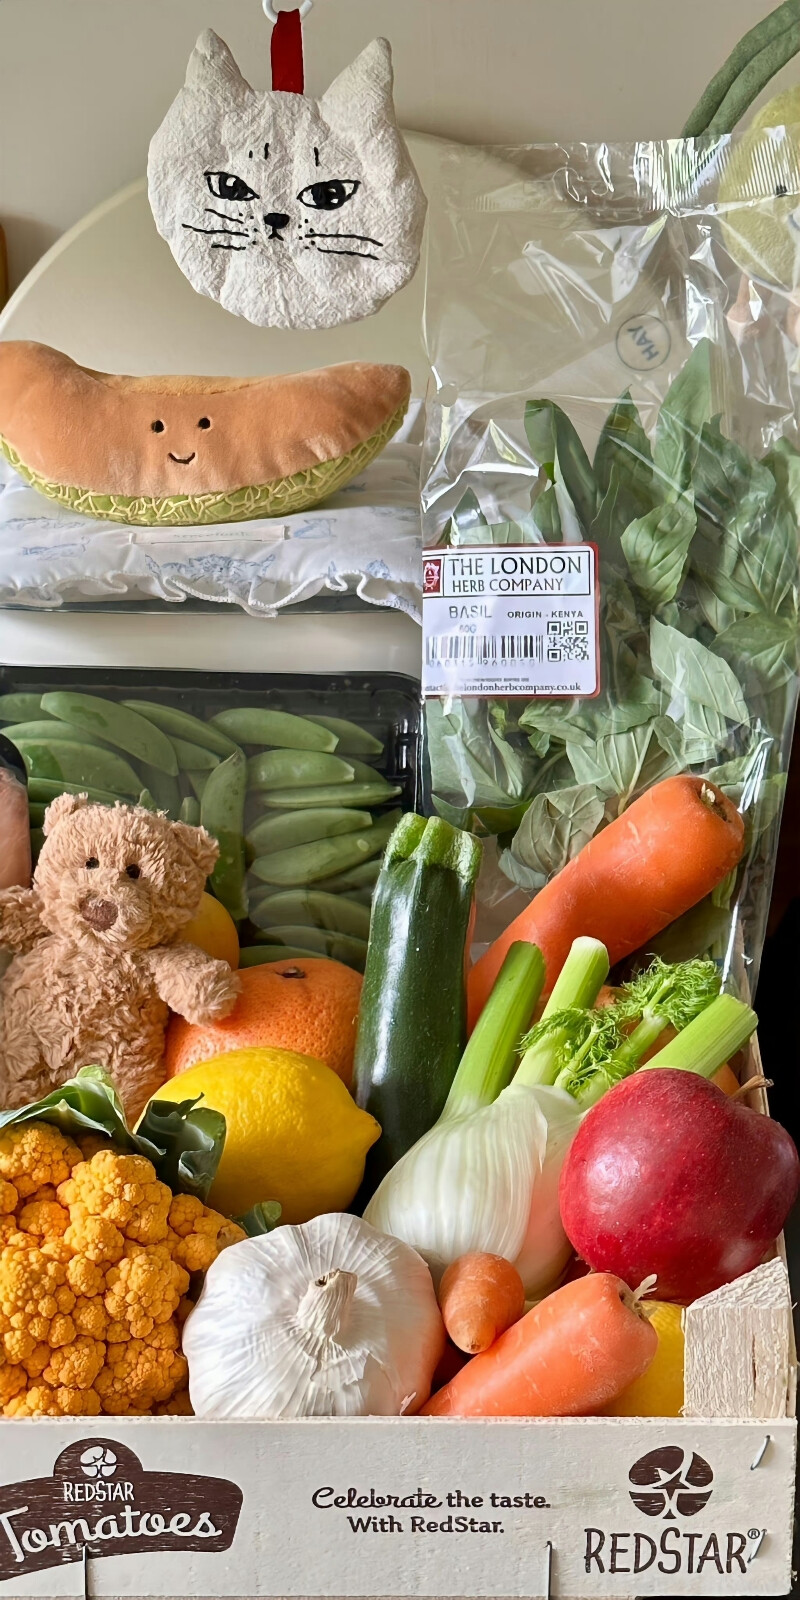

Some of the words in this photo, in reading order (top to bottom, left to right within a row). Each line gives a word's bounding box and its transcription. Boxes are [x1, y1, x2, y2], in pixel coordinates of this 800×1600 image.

[627, 325, 660, 361] HAY
[449, 557, 484, 576] THE
[491, 556, 581, 575] LONDON
[452, 579, 485, 593] HERB
[489, 578, 564, 592] COMPANY
[449, 605, 492, 619] BASIL
[507, 610, 542, 619] ORIGIN
[551, 610, 584, 618] KENYA
[63, 1480, 135, 1502] REDSTAR
[311, 1486, 443, 1509] Celebrate
[446, 1490, 484, 1509] the
[490, 1492, 551, 1509] taste.
[0, 1504, 223, 1563] Tomatoes
[346, 1515, 404, 1533] With
[410, 1515, 505, 1534] RedStar.
